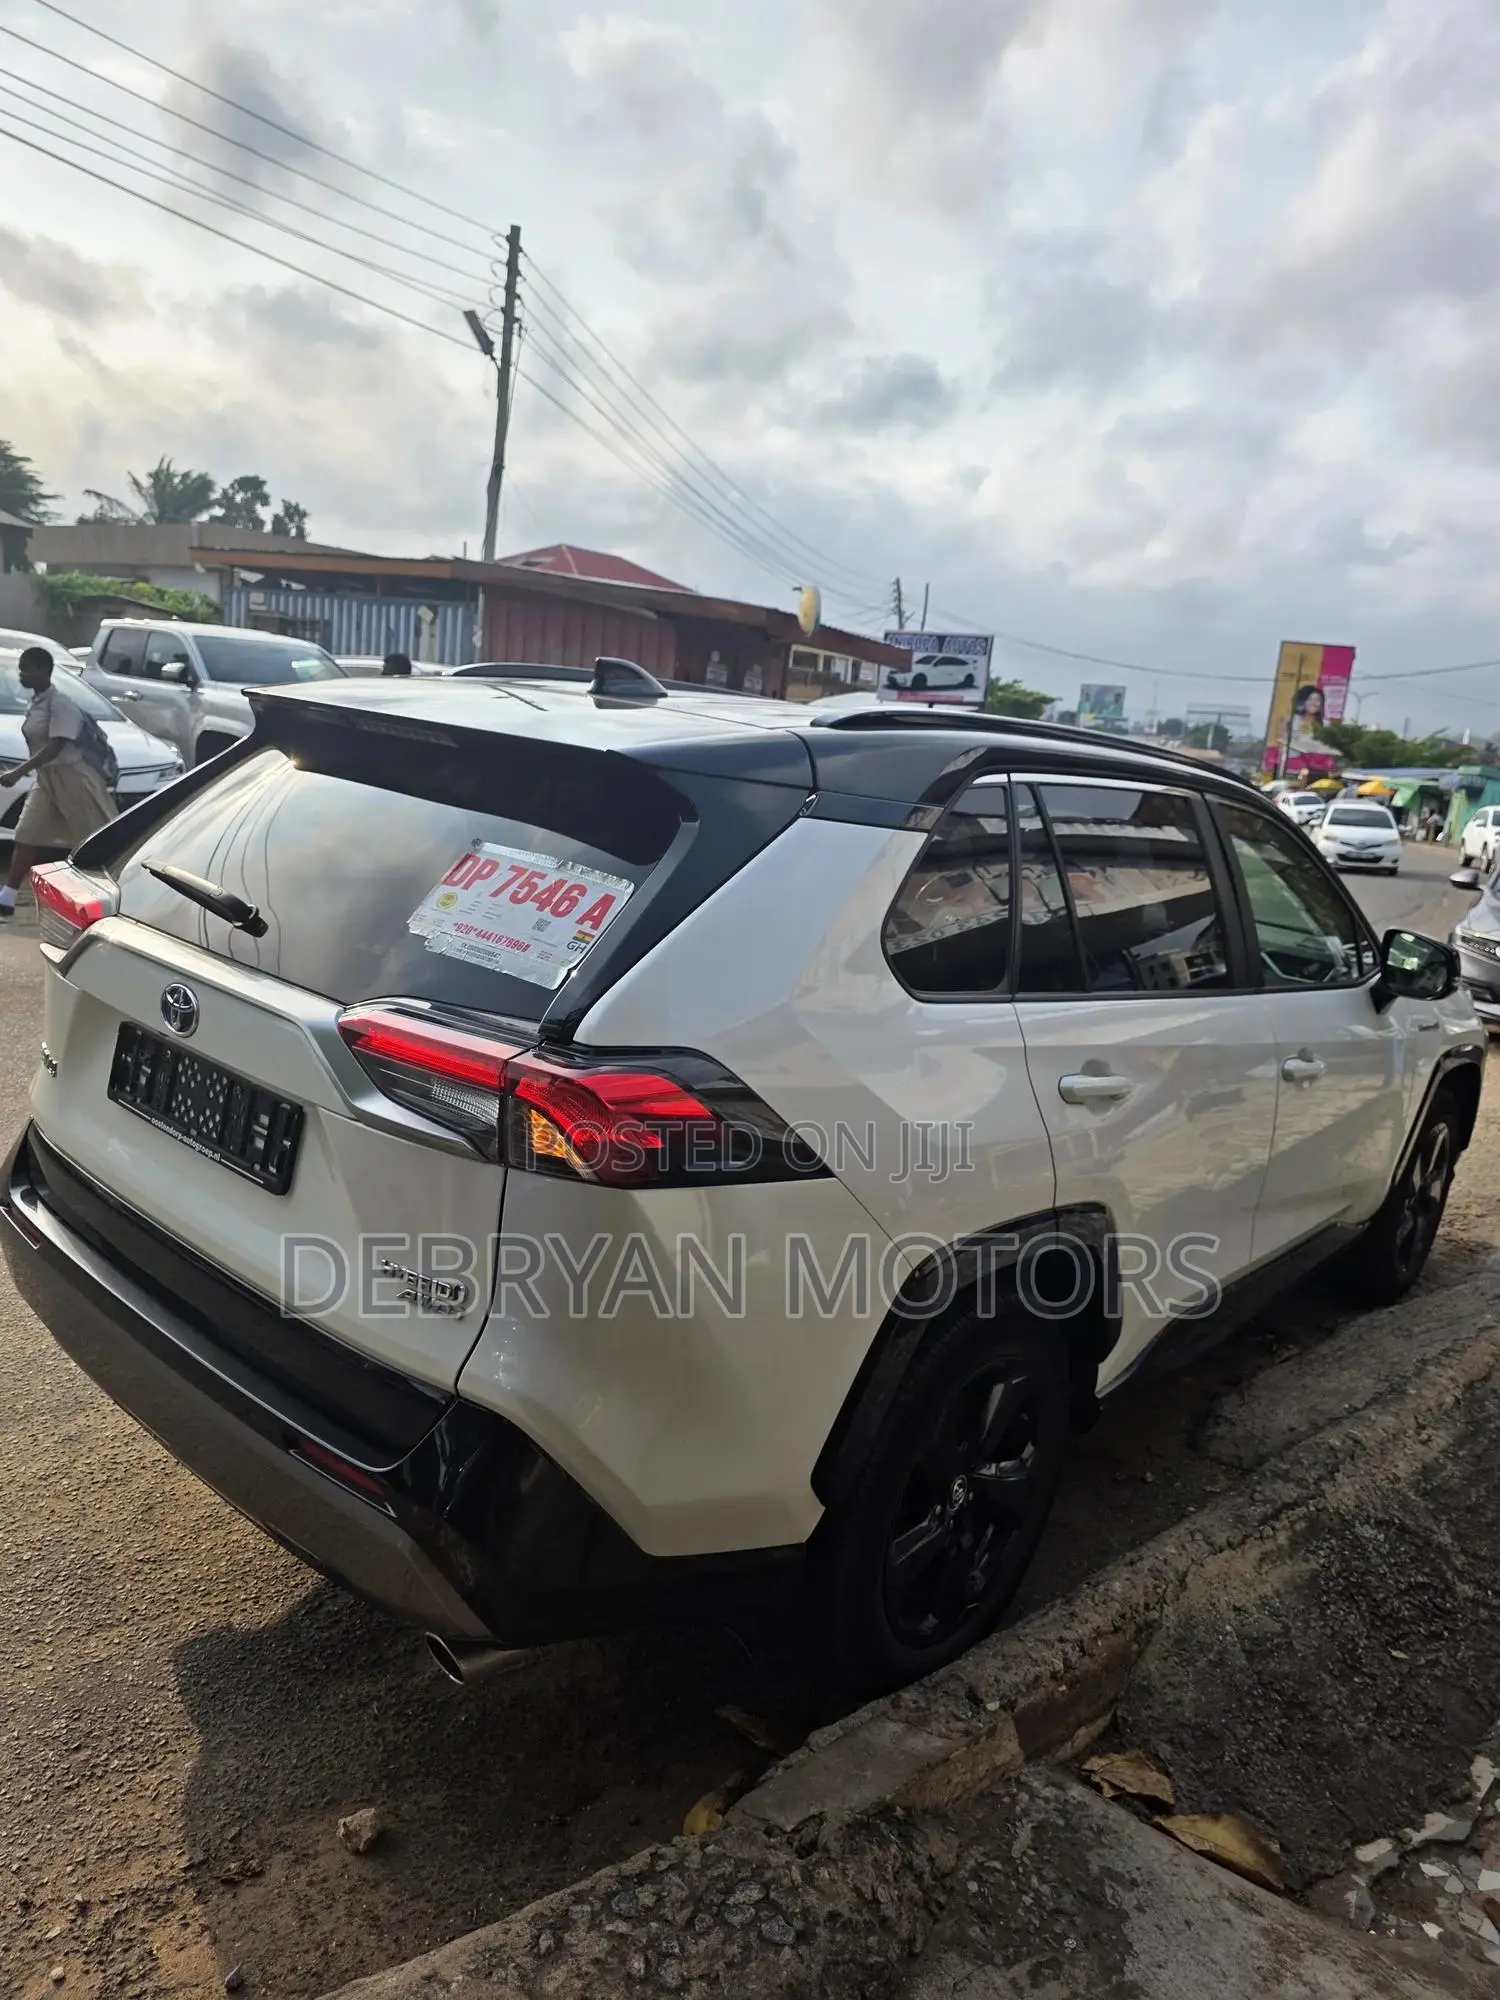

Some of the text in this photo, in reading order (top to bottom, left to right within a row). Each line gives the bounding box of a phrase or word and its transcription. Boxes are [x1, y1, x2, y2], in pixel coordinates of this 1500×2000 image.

[440, 852, 500, 891] DP
[488, 864, 588, 918] 7546
[575, 892, 617, 931] A
[566, 941, 588, 954] GH
